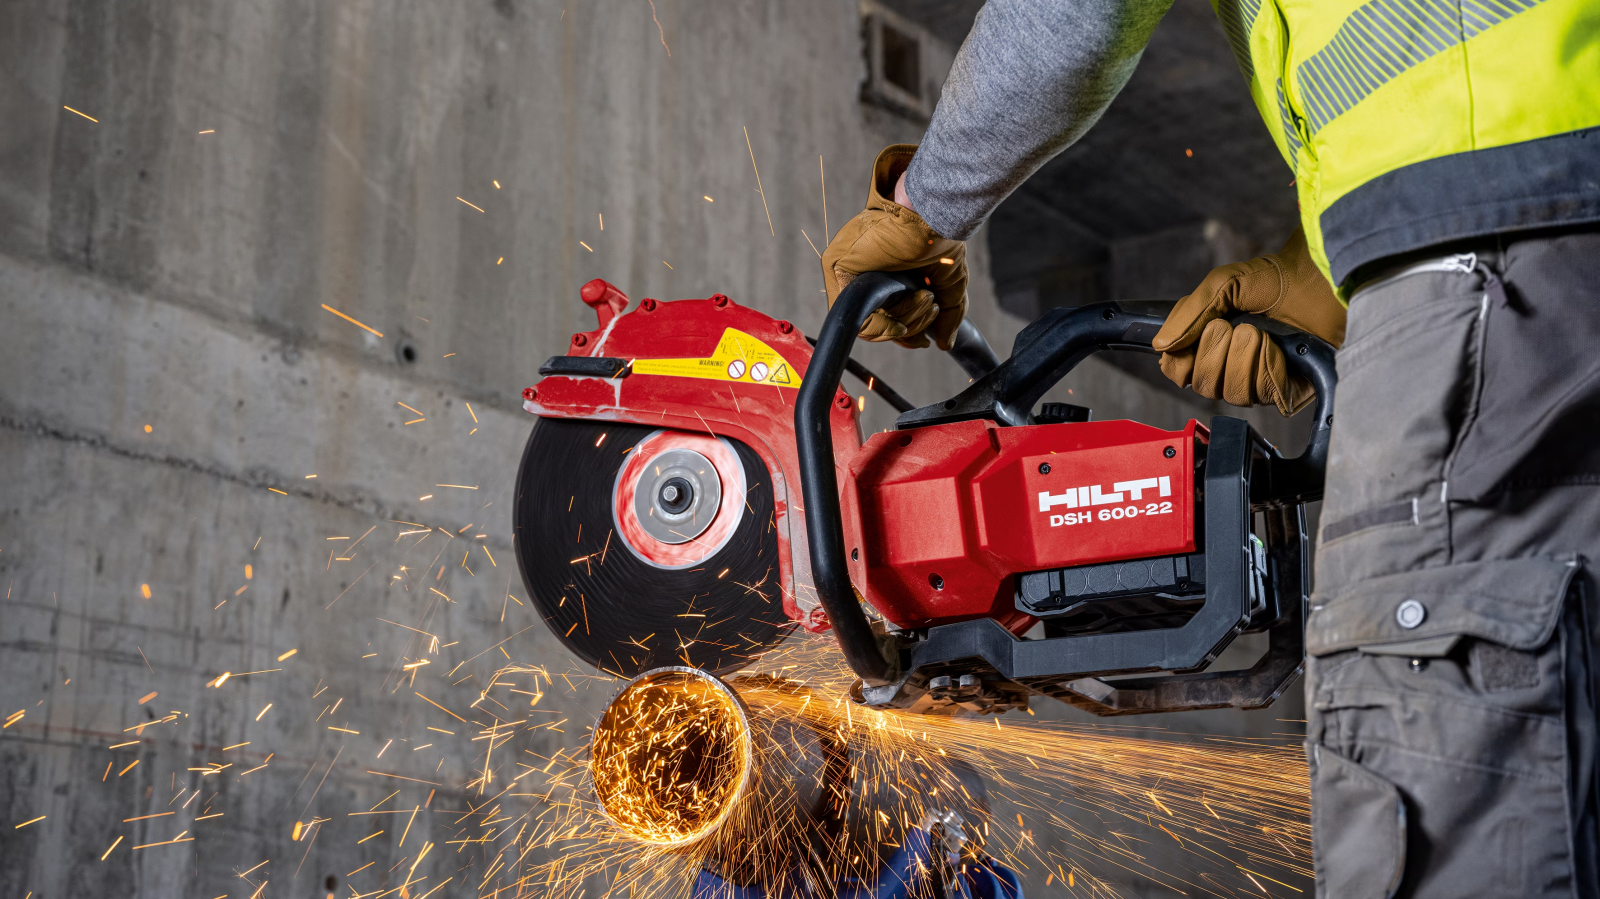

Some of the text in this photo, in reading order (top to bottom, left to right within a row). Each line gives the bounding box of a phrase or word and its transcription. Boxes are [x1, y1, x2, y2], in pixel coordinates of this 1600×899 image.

[1038, 475, 1172, 513] HILTI
[1050, 501, 1173, 527] DSH 600-22
